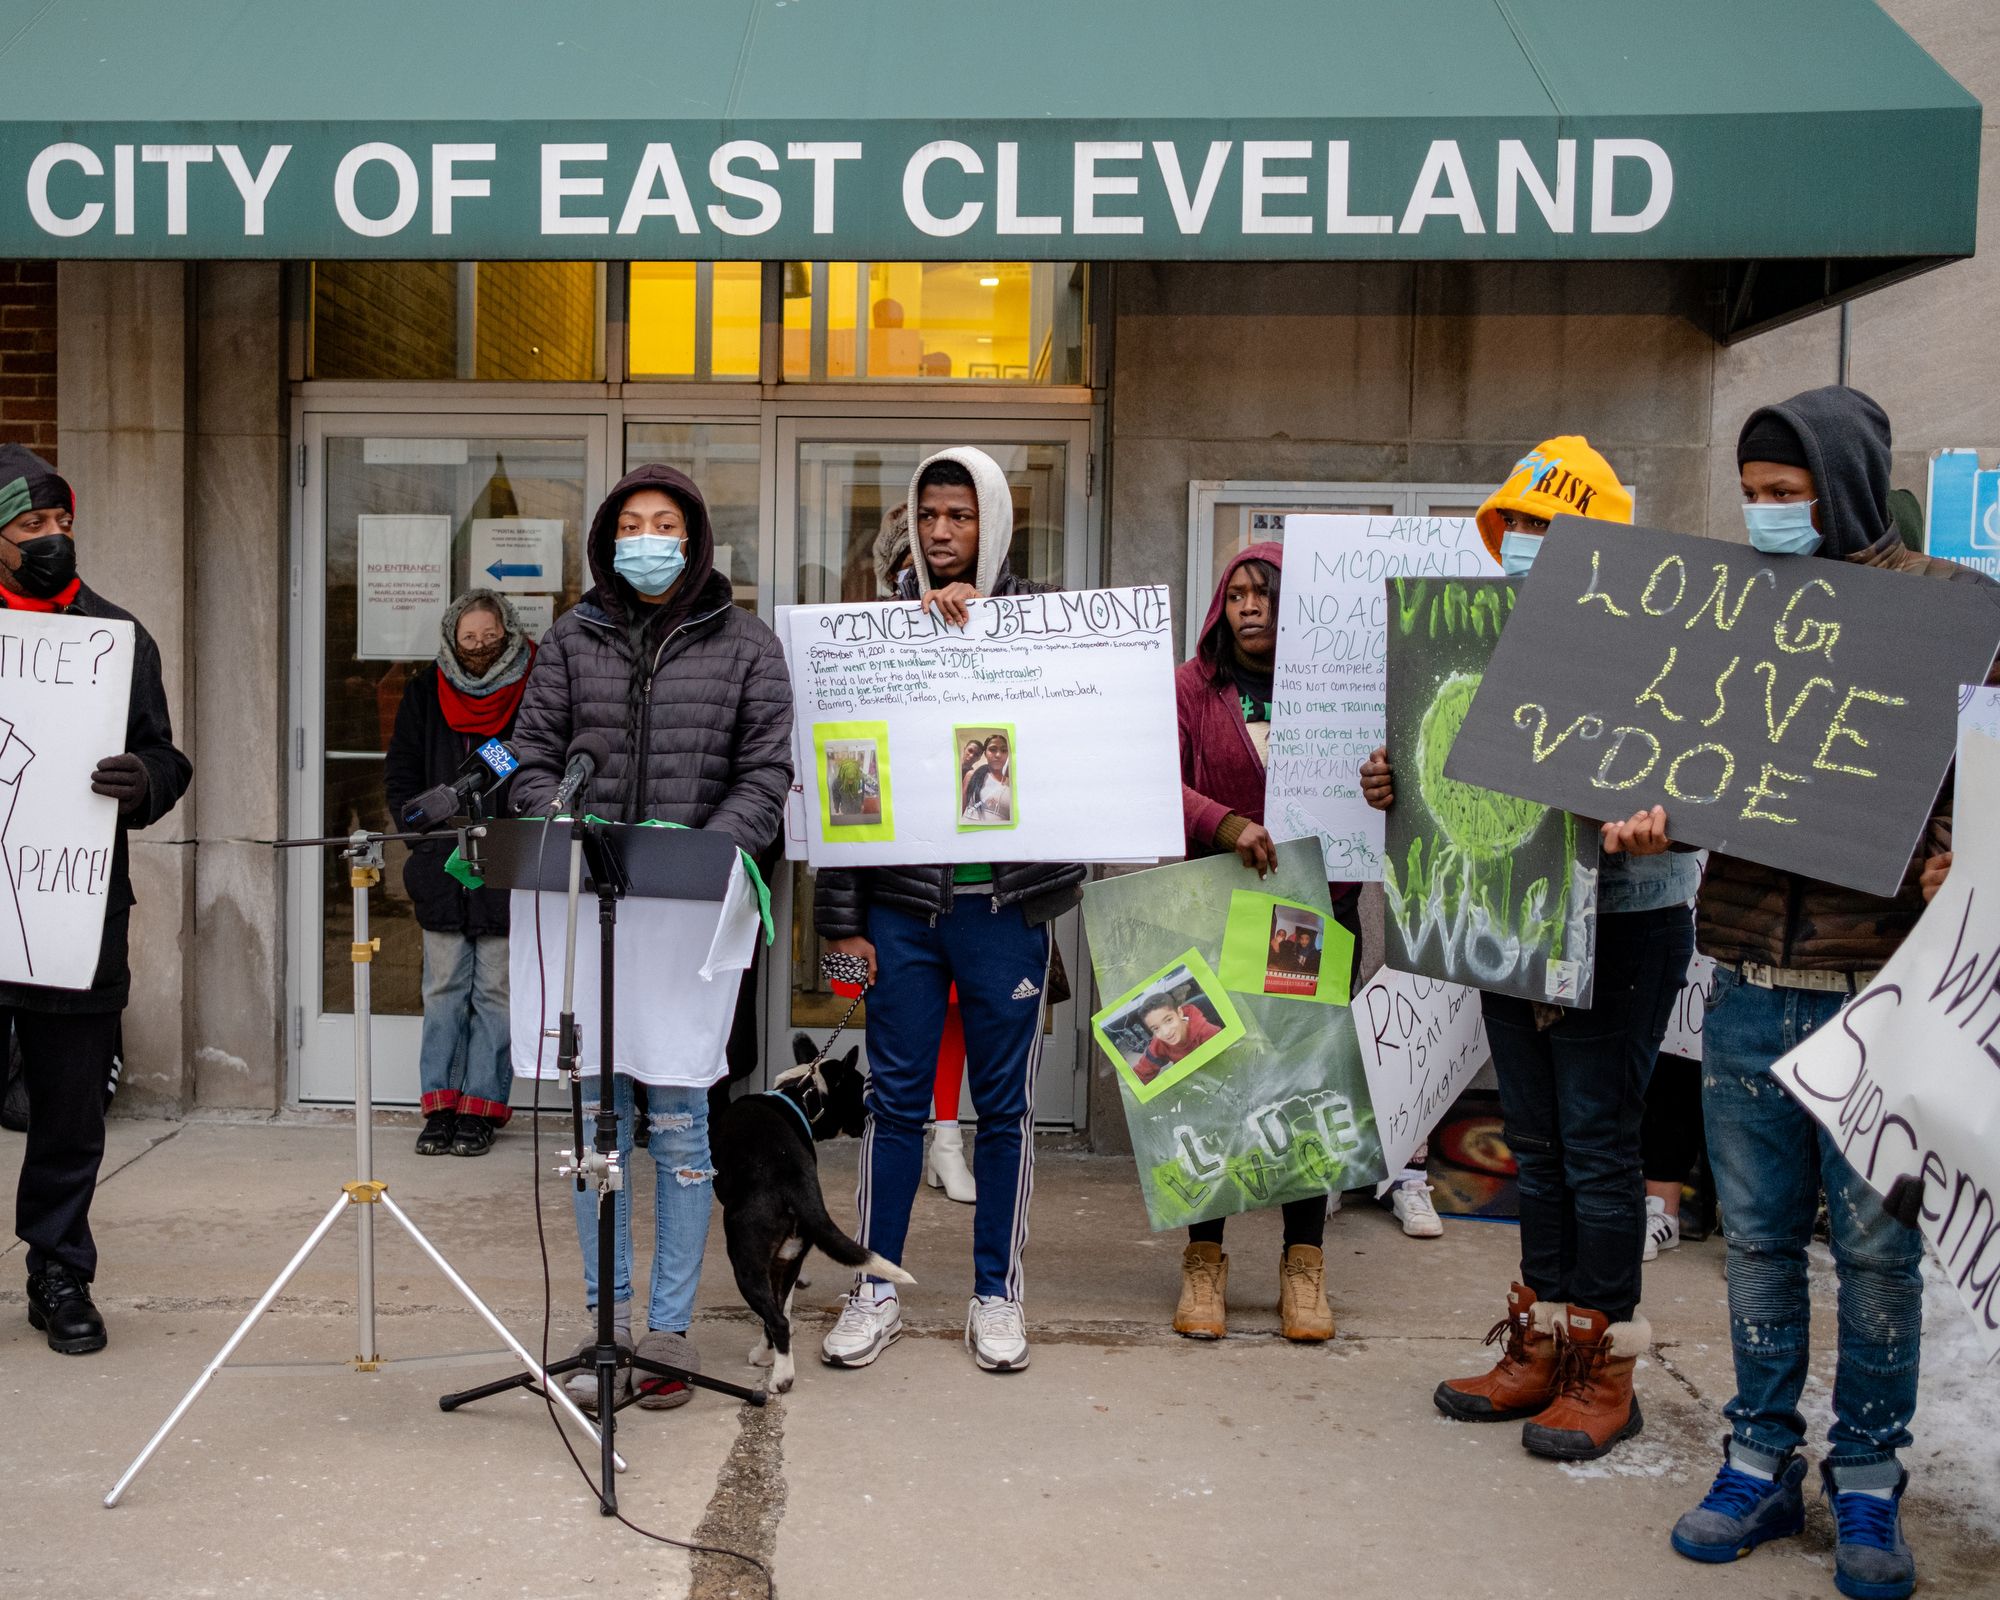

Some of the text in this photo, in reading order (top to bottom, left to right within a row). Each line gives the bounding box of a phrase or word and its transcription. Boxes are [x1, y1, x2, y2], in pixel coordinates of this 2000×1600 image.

[27, 139, 1674, 237] CITY OF EAST CLEVELAND
[1533, 465, 1597, 516] RISK
[1367, 517, 1467, 548] LARRY
[368, 564, 440, 572] NO ENTRANCE!
[1314, 549, 1481, 583] MCDONALD
[1299, 595, 1339, 625] NO
[1577, 550, 1841, 664] LONG
[810, 646, 854, 662] September
[1113, 639, 1160, 651] Encouraging
[815, 676, 826, 687] He
[830, 675, 847, 686] had
[858, 674, 873, 685] love
[875, 672, 887, 683] for
[891, 671, 903, 682] his
[906, 670, 921, 684] dog
[922, 670, 937, 680] like
[1285, 663, 1319, 674] MUST
[816, 687, 828, 698] He
[830, 685, 846, 696] had
[857, 685, 872, 695] love
[873, 684, 886, 694] for
[1278, 700, 1301, 716] NO
[1636, 647, 1908, 777] LIVE
[1356, 728, 1369, 739] to
[482, 749, 504, 773] SIDE
[486, 743, 511, 771] YOUR
[495, 744, 510, 761] ON
[17, 844, 109, 896] PEACE!
[1011, 987, 1040, 1000] adidas
